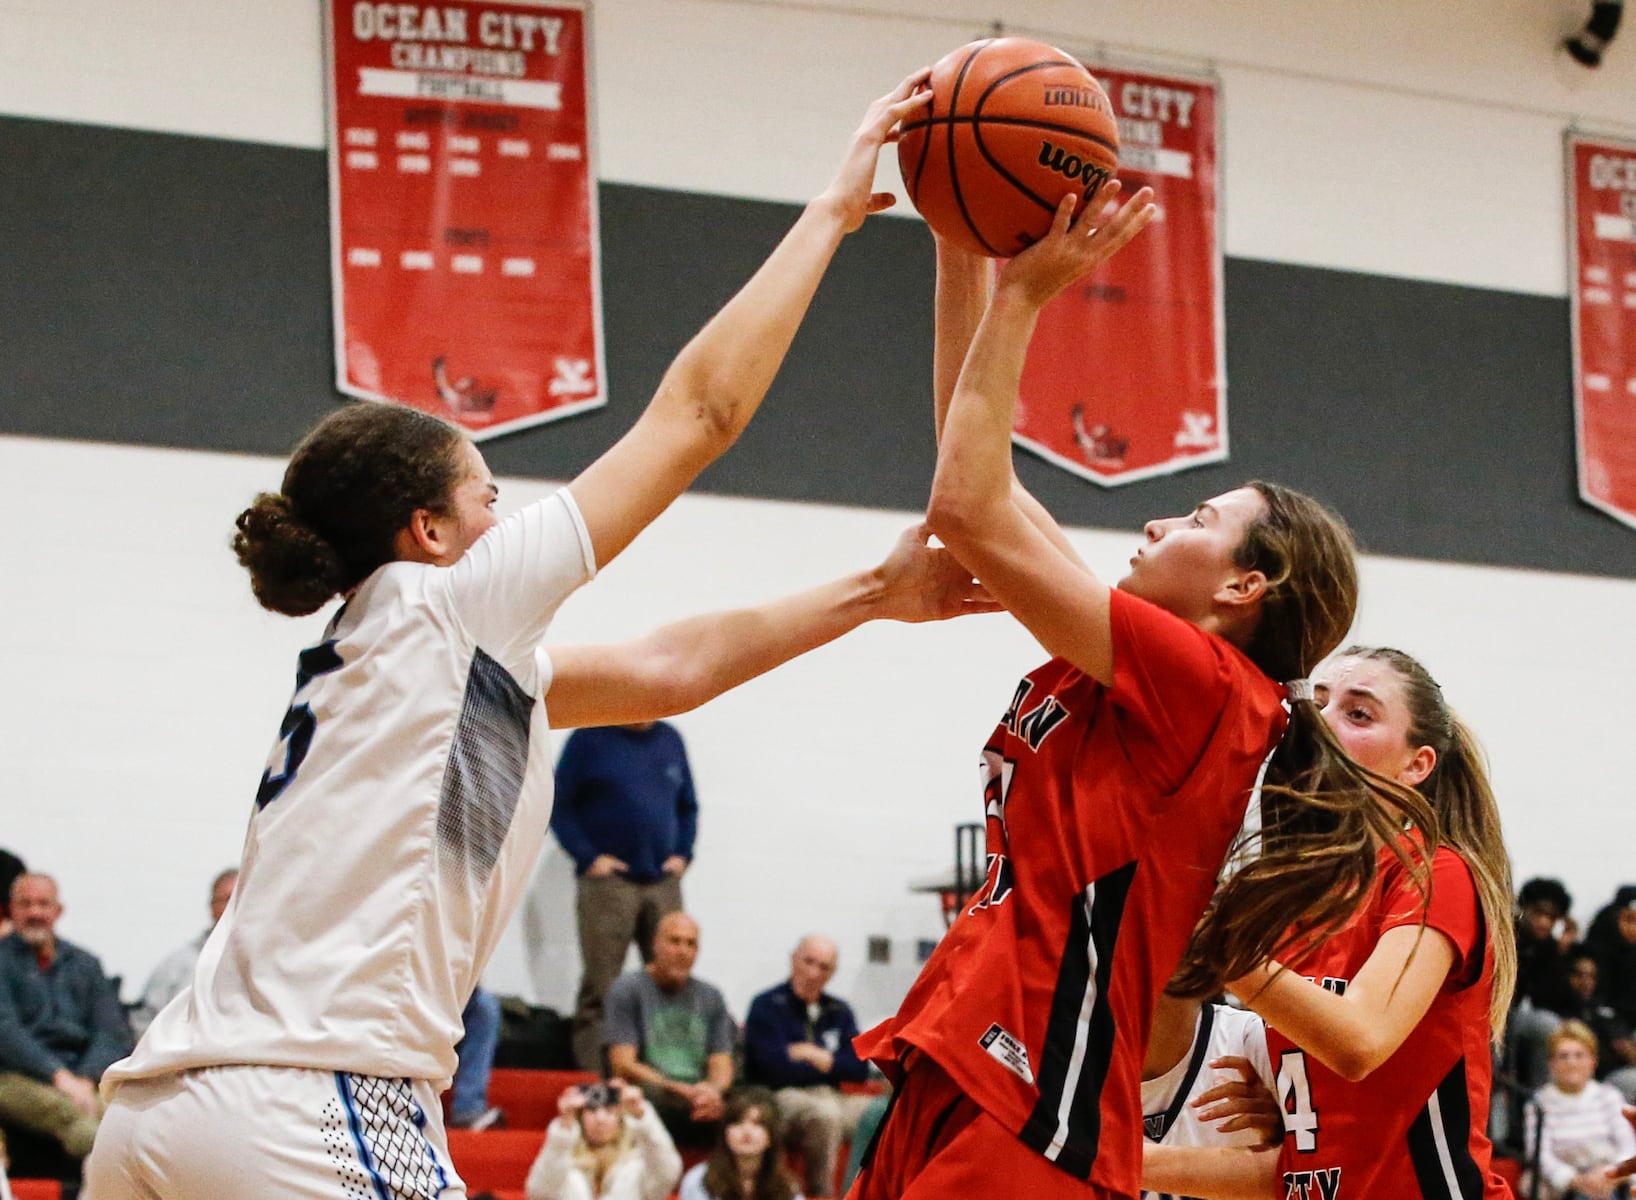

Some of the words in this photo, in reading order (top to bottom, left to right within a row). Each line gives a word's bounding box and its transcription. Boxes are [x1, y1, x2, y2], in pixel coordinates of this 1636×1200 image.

[352, 1, 468, 43] OCEAN
[479, 11, 562, 55] CITY
[1122, 82, 1195, 128] CITY
[1276, 1048, 1320, 1153] 4
